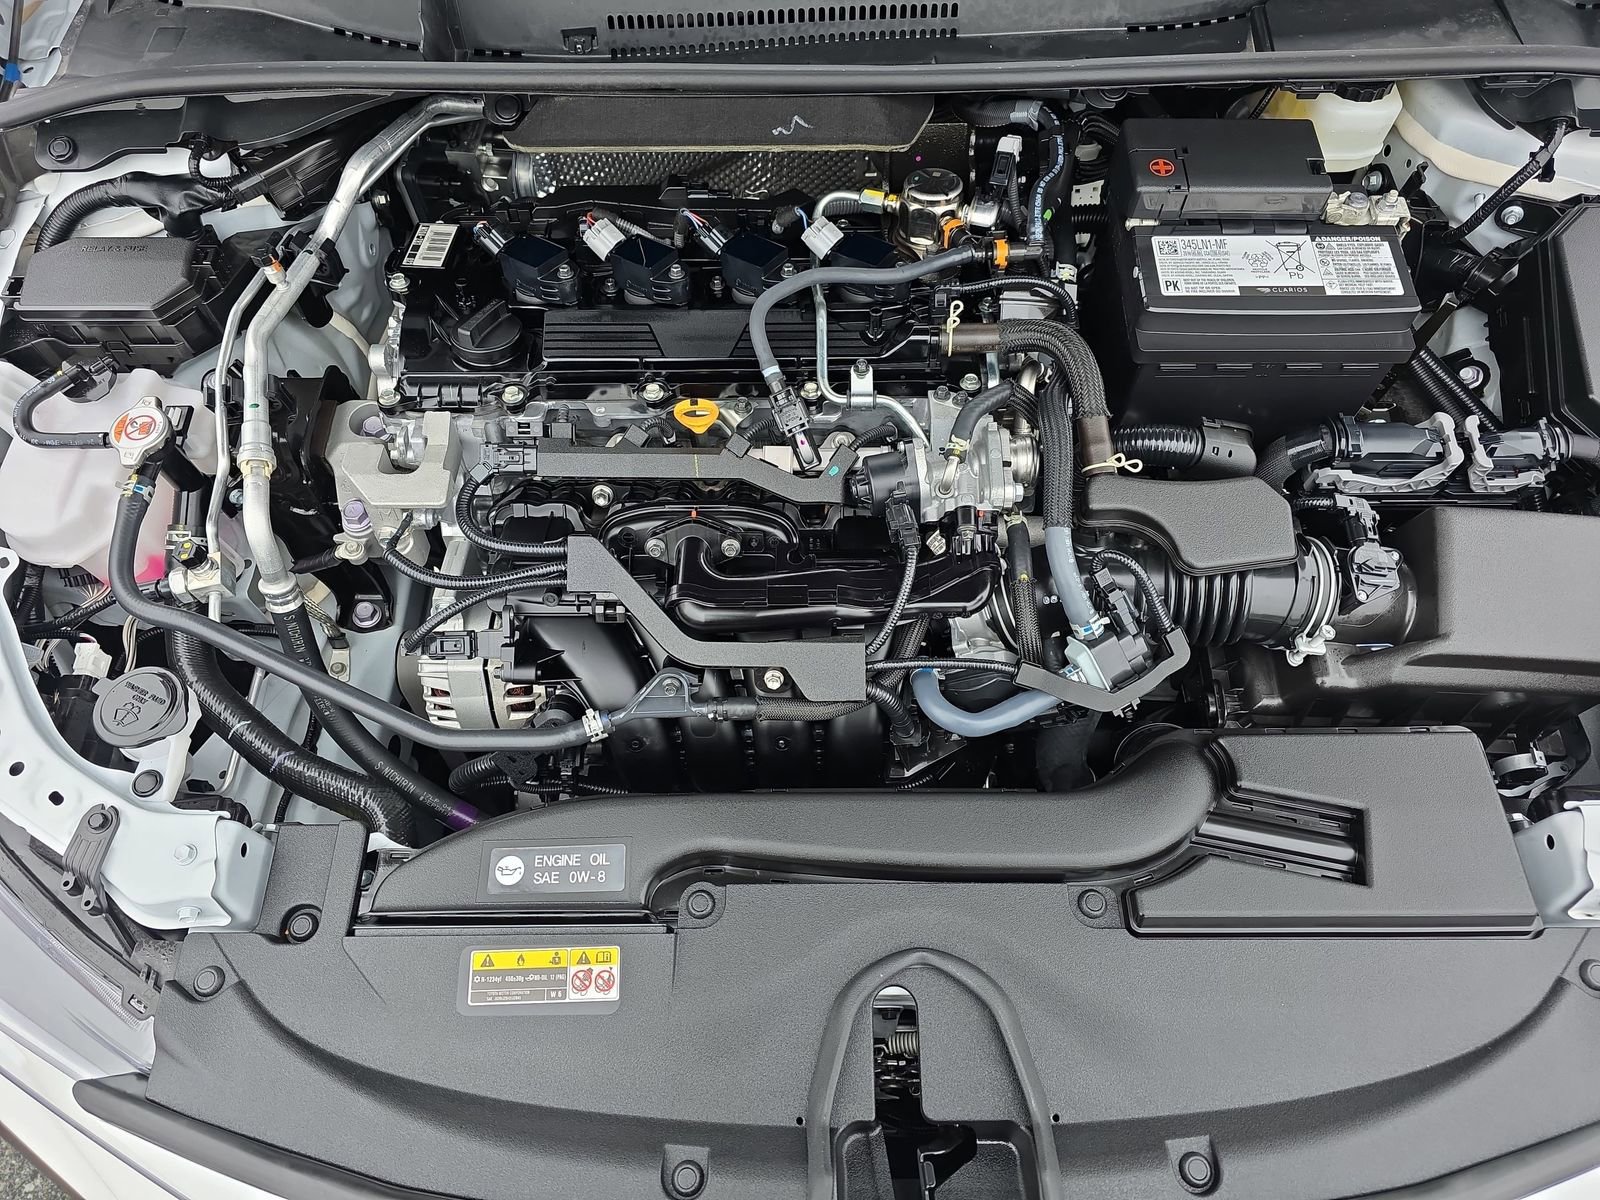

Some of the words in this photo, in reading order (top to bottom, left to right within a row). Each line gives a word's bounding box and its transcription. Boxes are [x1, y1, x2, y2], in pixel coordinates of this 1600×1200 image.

[1181, 239, 1228, 250] 345LN1-MF
[1289, 271, 1304, 280] Pb
[1165, 280, 1182, 292] PK
[286, 621, 307, 653] NICHIRIN
[381, 766, 417, 794] NICHIRIN
[534, 854, 582, 867] ENGINE
[589, 853, 611, 866] OIL
[533, 872, 560, 884] SAE
[569, 870, 606, 884] 0W-8
